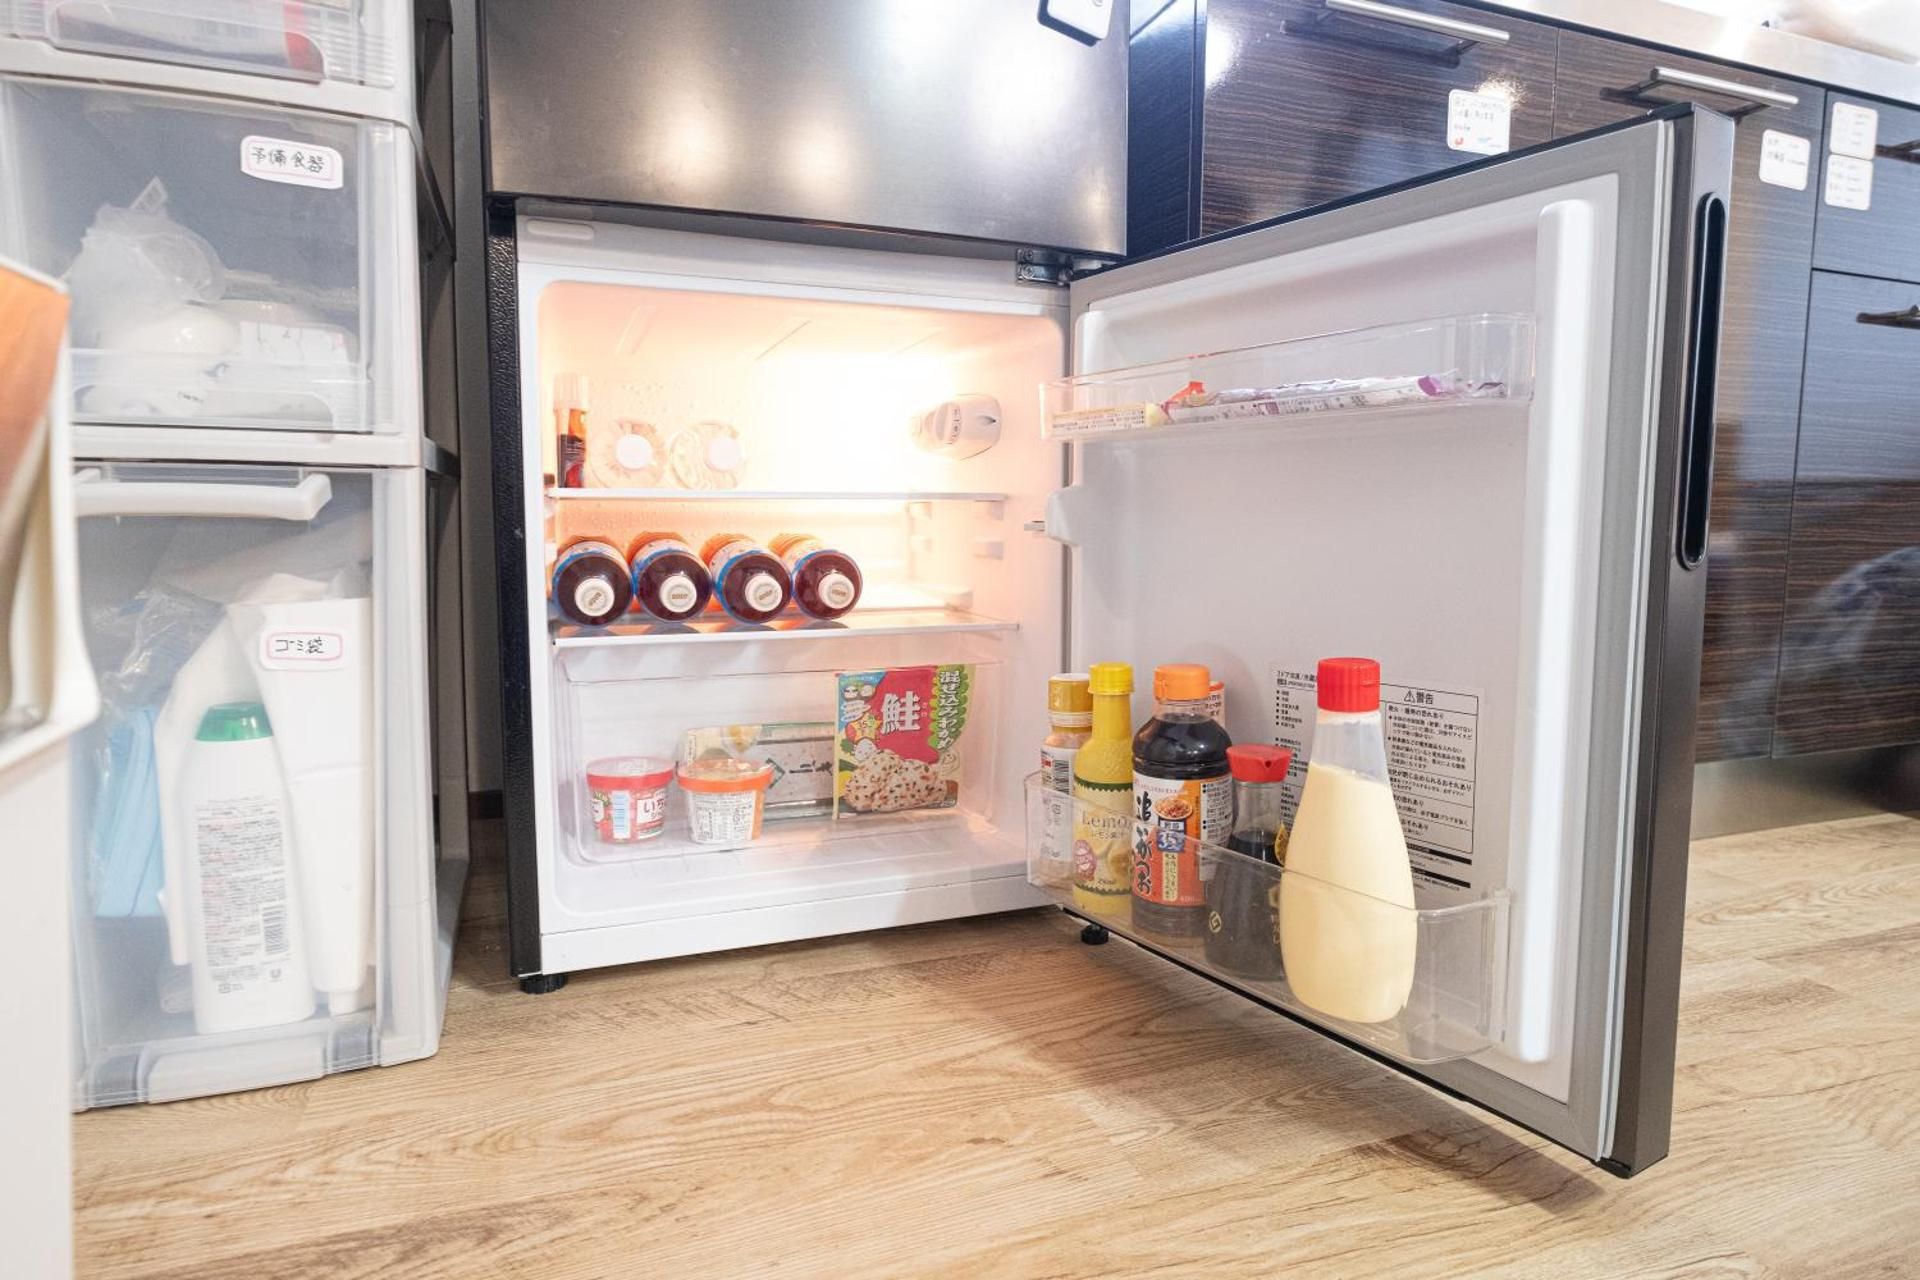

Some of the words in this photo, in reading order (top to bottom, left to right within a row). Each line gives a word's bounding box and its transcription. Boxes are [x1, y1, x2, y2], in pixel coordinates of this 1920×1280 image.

[251, 146, 325, 173] 予備食器
[275, 636, 324, 654] ゴミ袋
[880, 690, 921, 735] 鮭
[937, 670, 961, 750] 混ぜ込みわかめ
[1416, 692, 1433, 704] 警告
[1135, 790, 1153, 894] 追いがつお
